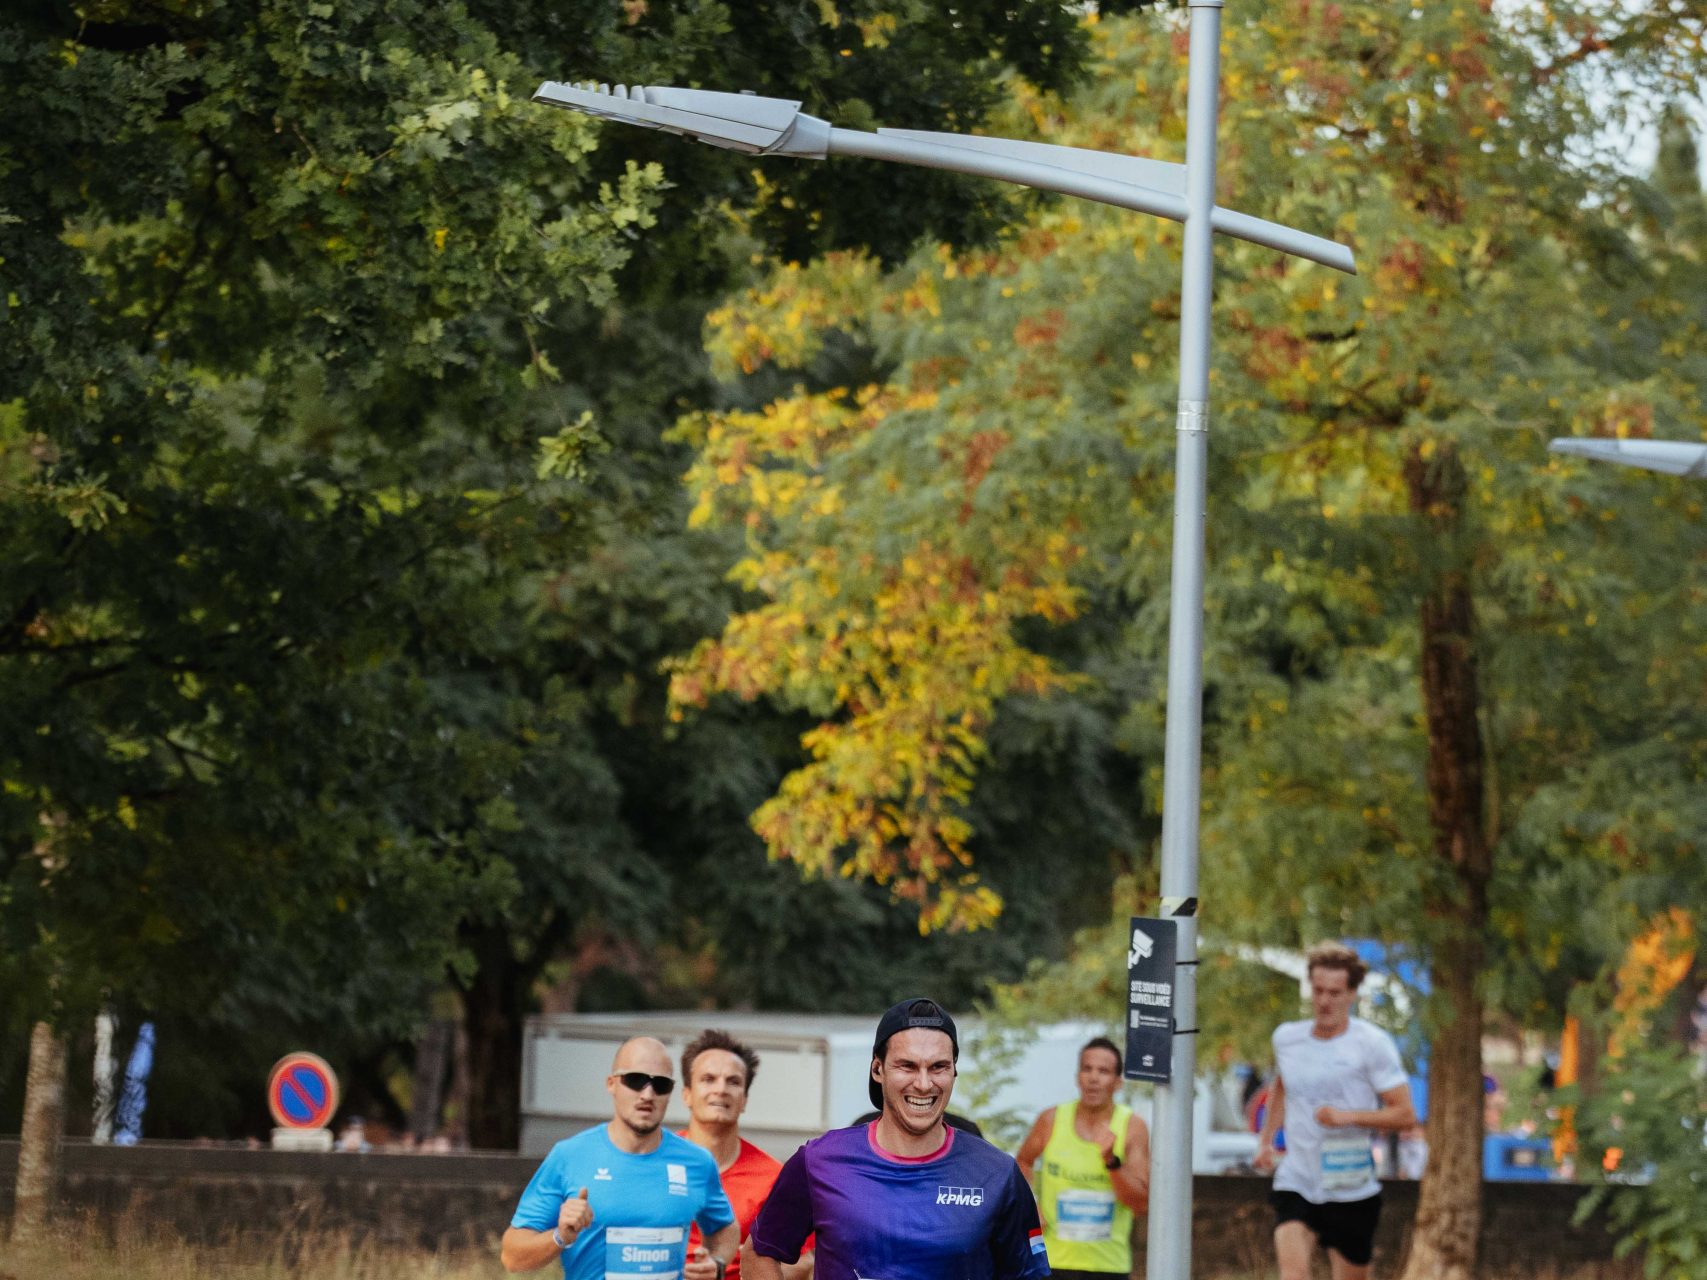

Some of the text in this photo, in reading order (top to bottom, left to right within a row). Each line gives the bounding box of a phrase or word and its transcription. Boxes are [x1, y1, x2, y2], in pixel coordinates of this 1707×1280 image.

[1131, 980, 1142, 992] SITE
[1130, 992, 1171, 1007] SURVEILLANCE
[936, 1193, 982, 1206] KPMG
[622, 1246, 670, 1262] Simon
